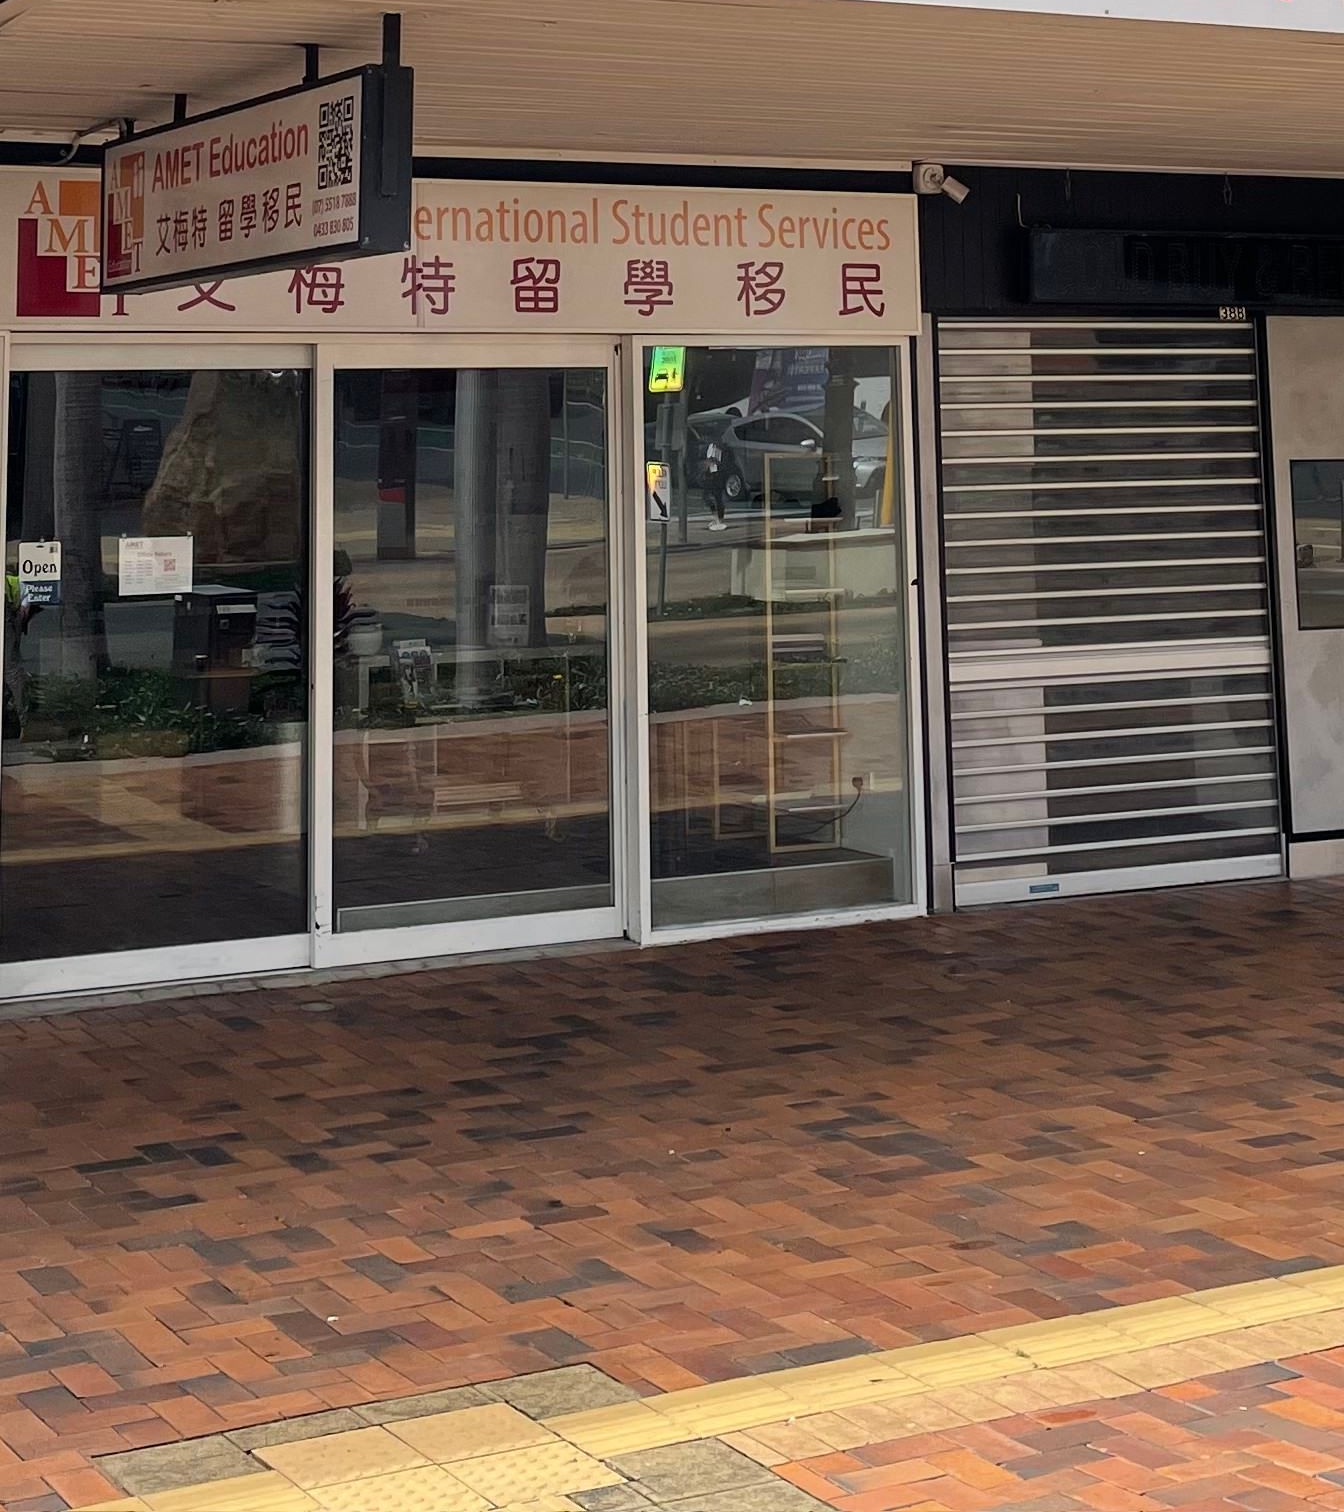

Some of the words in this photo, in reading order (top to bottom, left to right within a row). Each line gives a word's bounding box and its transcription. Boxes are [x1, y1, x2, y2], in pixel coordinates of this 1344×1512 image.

[152, 142, 204, 193] AMET
[209, 121, 308, 178] Education
[414, 197, 599, 244] ernational
[612, 199, 749, 248] Student
[757, 203, 891, 252] Services
[22, 560, 58, 576] Open
[26, 585, 53, 593] Please
[27, 593, 51, 602] Enter
